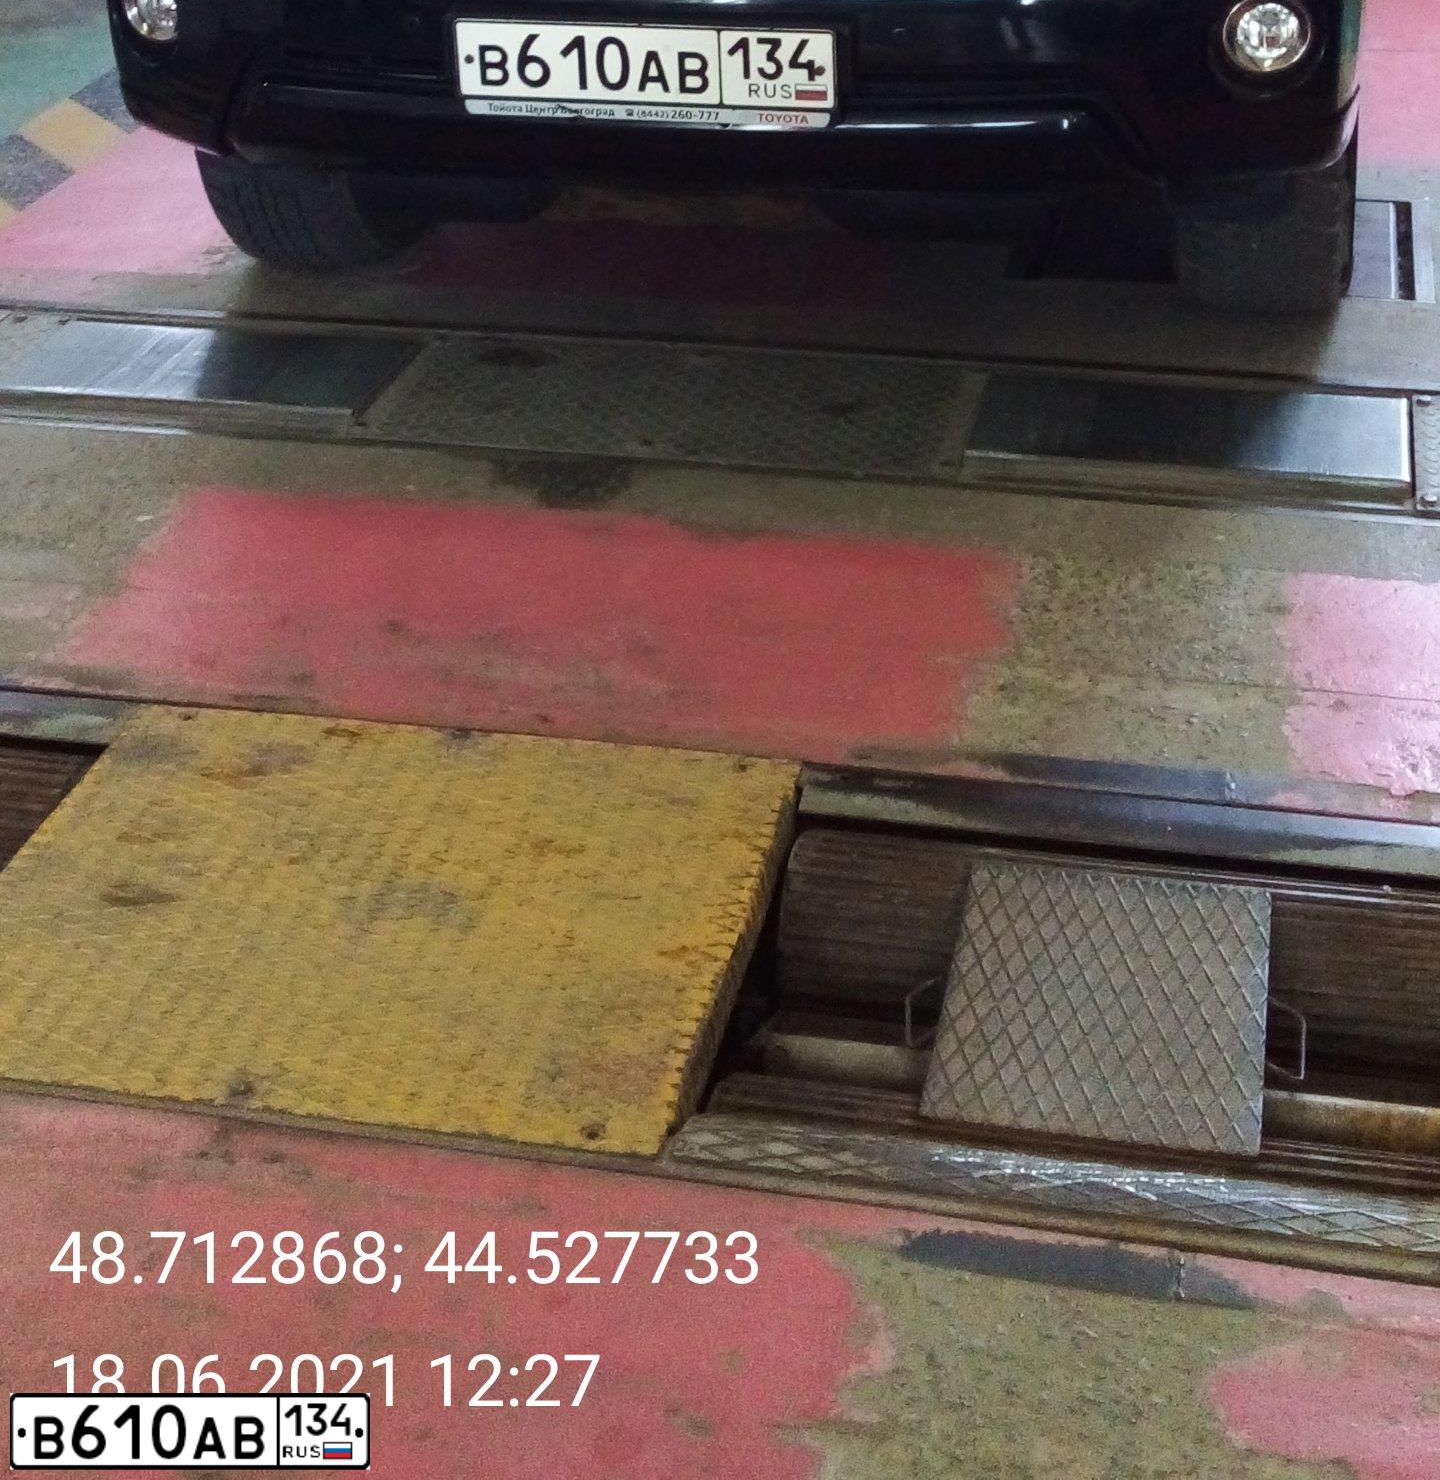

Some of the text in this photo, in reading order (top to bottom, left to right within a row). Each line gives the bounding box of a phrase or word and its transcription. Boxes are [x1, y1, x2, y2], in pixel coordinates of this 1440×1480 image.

[478, 33, 709, 94] В610АВ
[727, 37, 816, 82] 134
[748, 83, 792, 99] RUS
[488, 102, 615, 117] Тойота Центр Вгоград
[671, 110, 720, 121] 260-777
[758, 113, 809, 125] TOYOTA
